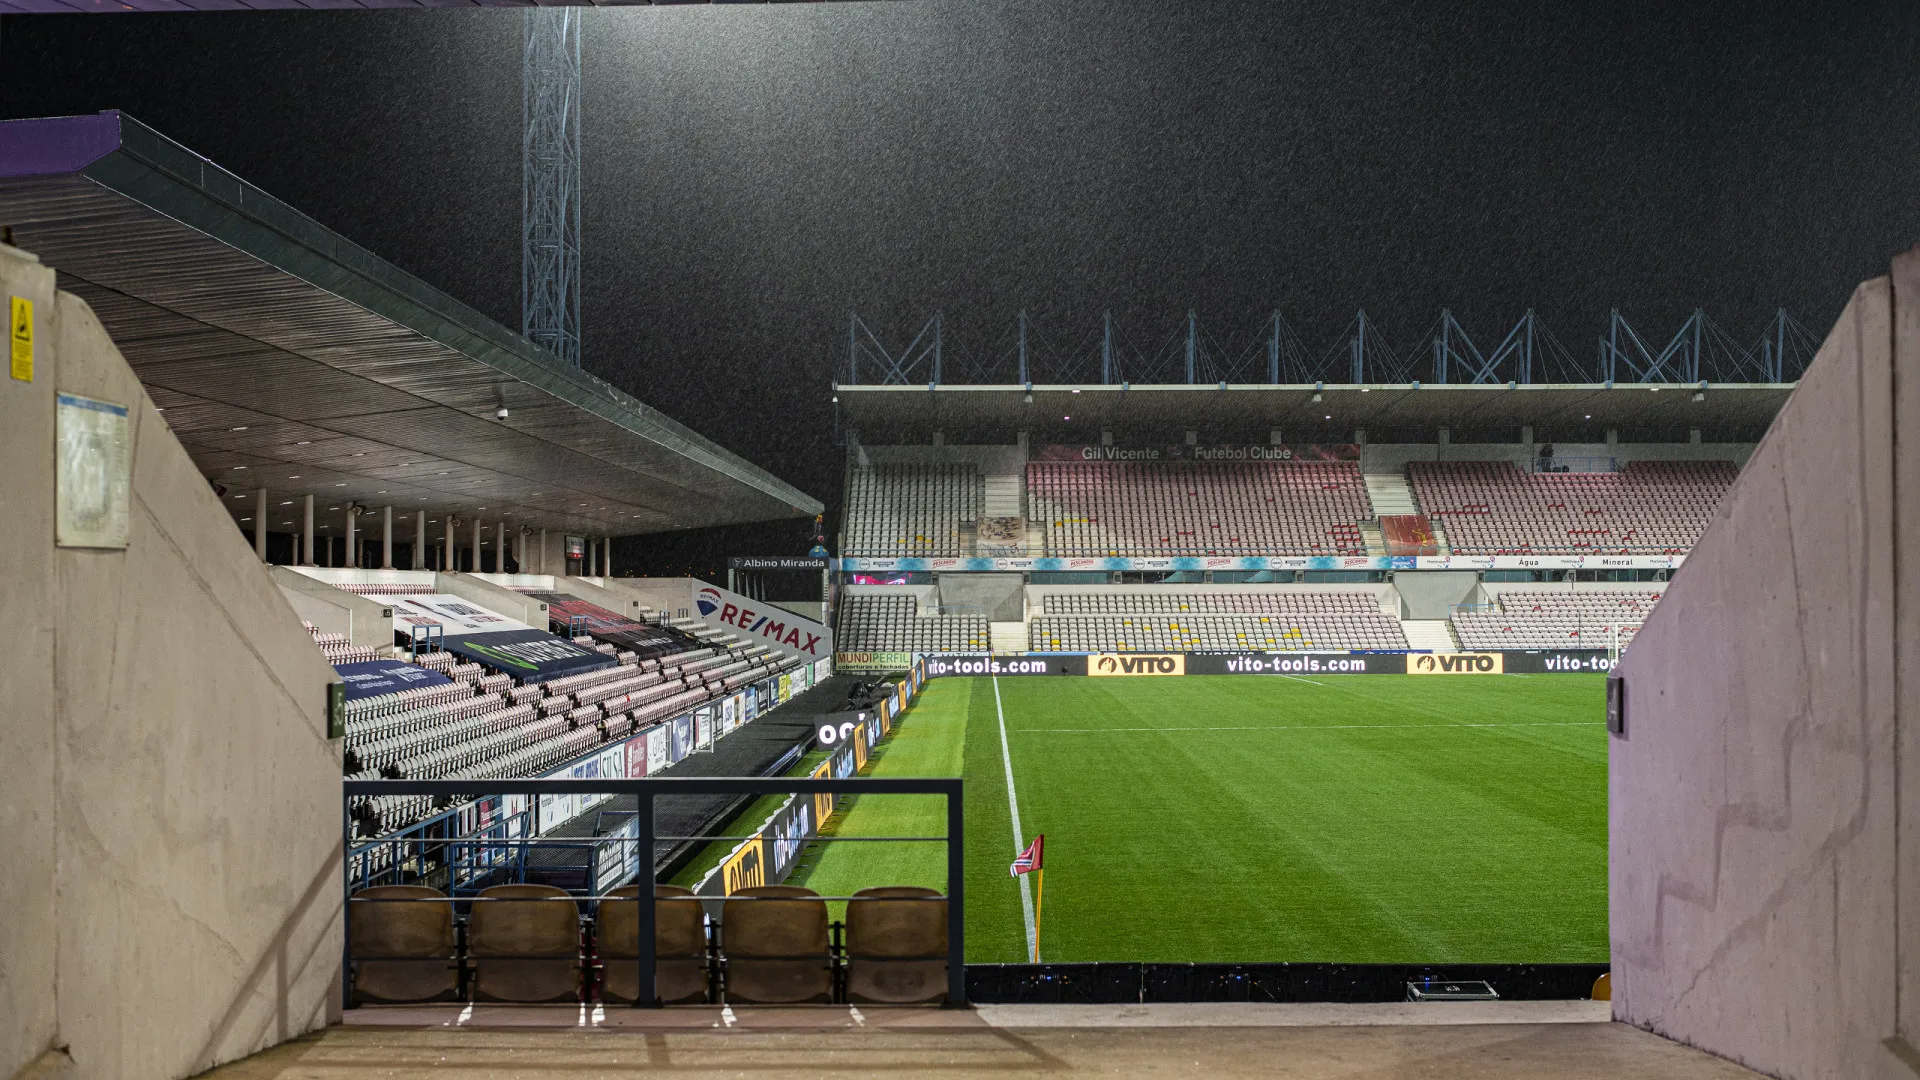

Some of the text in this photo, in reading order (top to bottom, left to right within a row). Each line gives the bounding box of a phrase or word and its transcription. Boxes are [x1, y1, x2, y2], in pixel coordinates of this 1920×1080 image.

[1081, 446, 1160, 460] Gil Vicente
[1194, 446, 1292, 459] Futebol Clube
[743, 558, 825, 568] Albino Miranda
[1518, 557, 1634, 567] Água Mineral
[719, 602, 822, 656] RE/MAX
[837, 652, 909, 664] MUNDIPERFIL
[1118, 656, 1176, 673] VITO
[1226, 656, 1366, 671] vito-tools.com
[1437, 655, 1495, 672] VITO
[928, 657, 1047, 675] vito-tools.com
